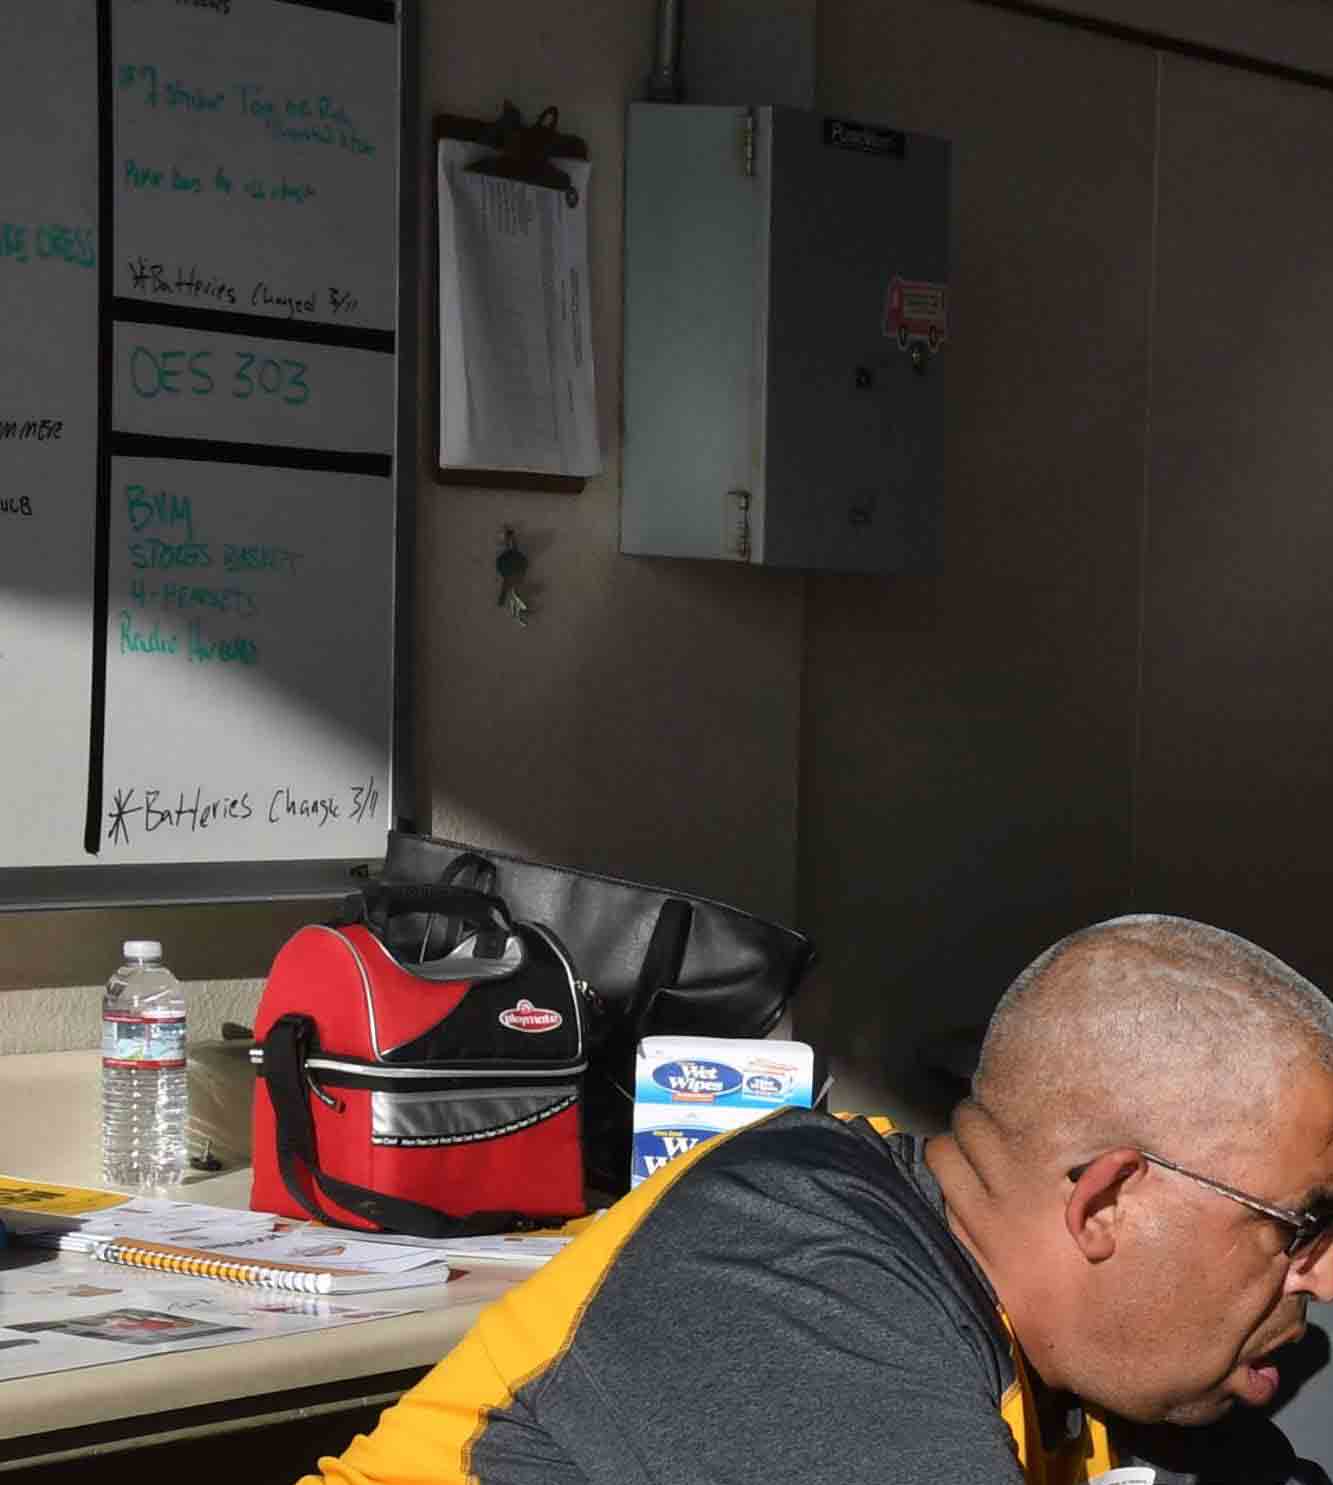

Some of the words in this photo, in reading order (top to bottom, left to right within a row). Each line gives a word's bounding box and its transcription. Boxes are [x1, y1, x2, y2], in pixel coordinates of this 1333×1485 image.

[130, 346, 214, 399] OES
[233, 351, 311, 406] 303
[146, 786, 252, 832] Batteries
[667, 1077, 725, 1093] Wipes
[678, 1062, 720, 1080] Wet
